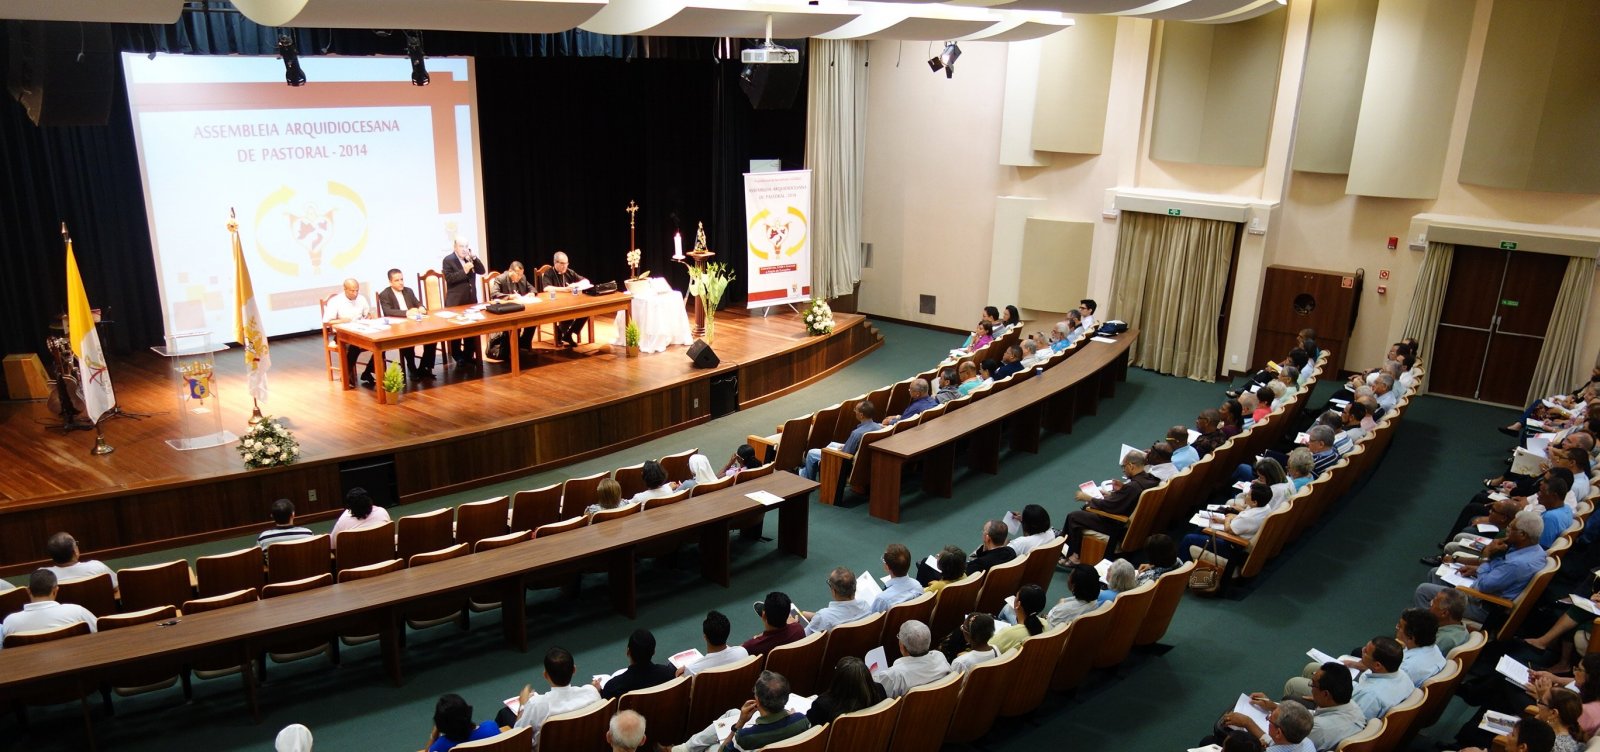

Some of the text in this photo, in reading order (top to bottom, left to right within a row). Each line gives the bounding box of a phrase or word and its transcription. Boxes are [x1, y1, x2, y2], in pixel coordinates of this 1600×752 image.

[194, 120, 400, 139] ASSEMBLEIA ARQUIDIOCESANA
[237, 148, 256, 162] DE
[262, 146, 329, 161] PASTORAL
[339, 144, 368, 158] 2014
